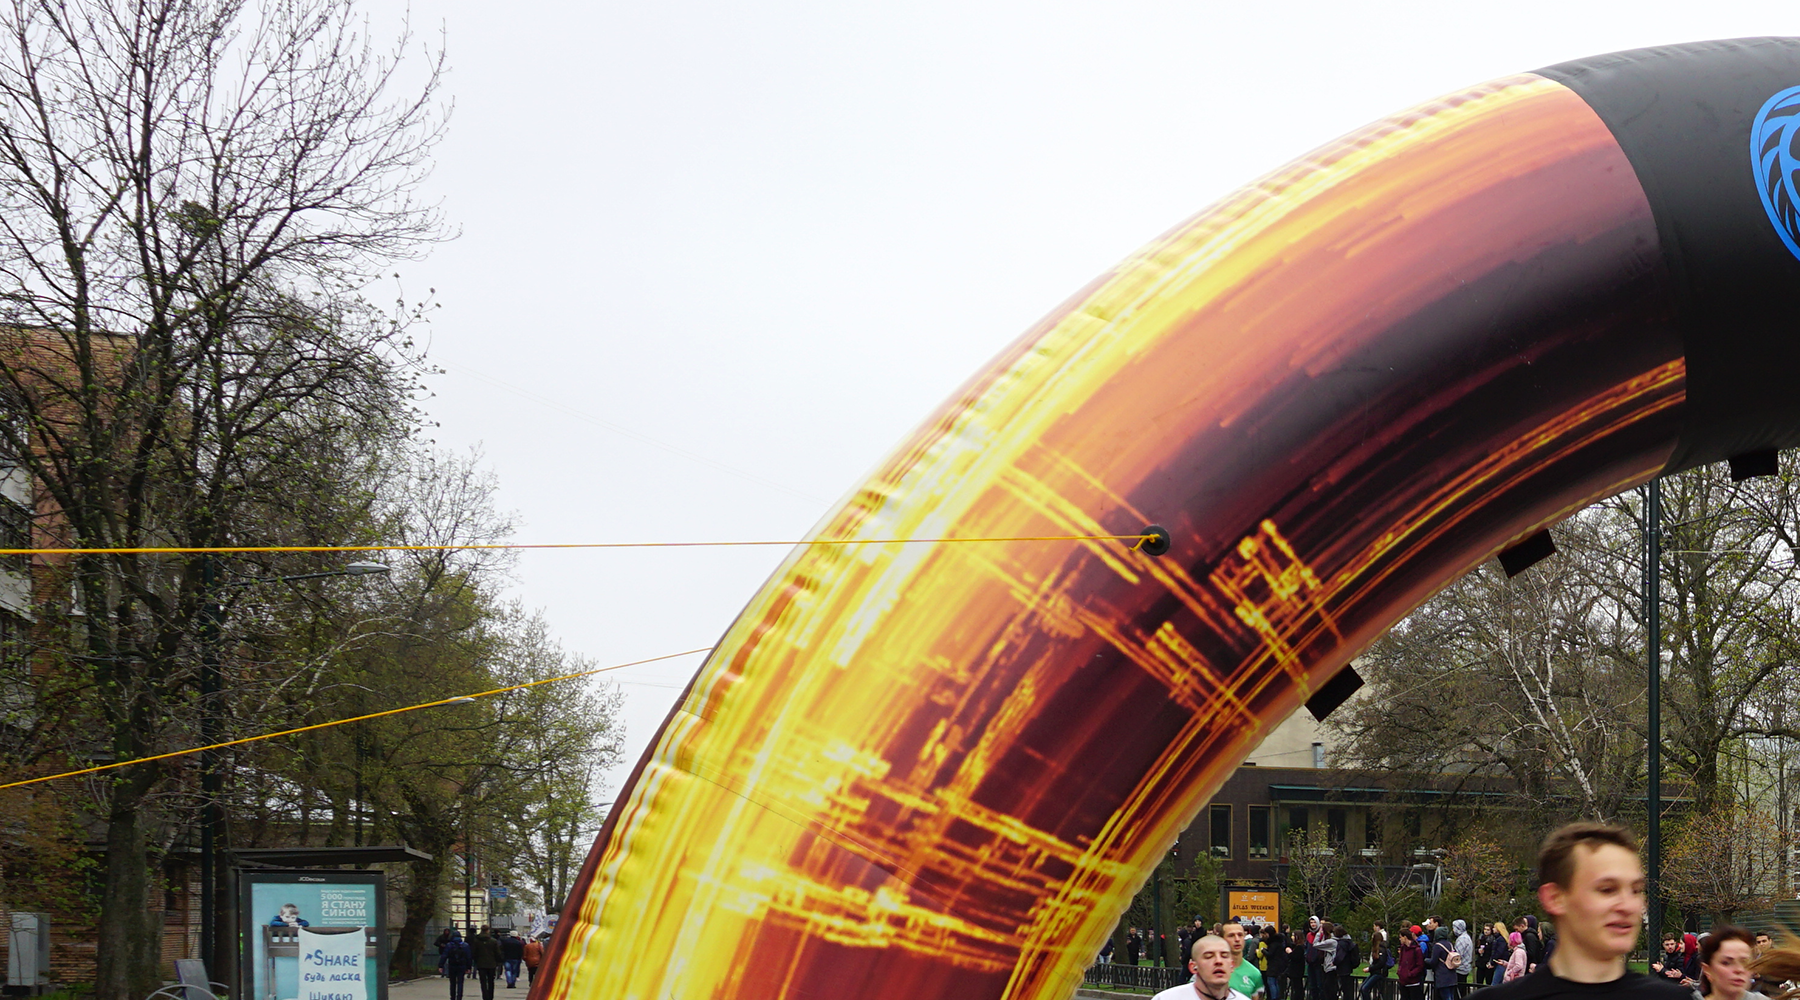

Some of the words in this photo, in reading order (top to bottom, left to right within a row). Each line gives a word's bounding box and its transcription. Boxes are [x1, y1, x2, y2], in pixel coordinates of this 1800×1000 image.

[321, 901, 329, 909] Я
[330, 900, 366, 909] СТАНУ
[321, 908, 366, 917] СИНОМ
[304, 972, 326, 983] будь
[329, 973, 362, 982] ласка
